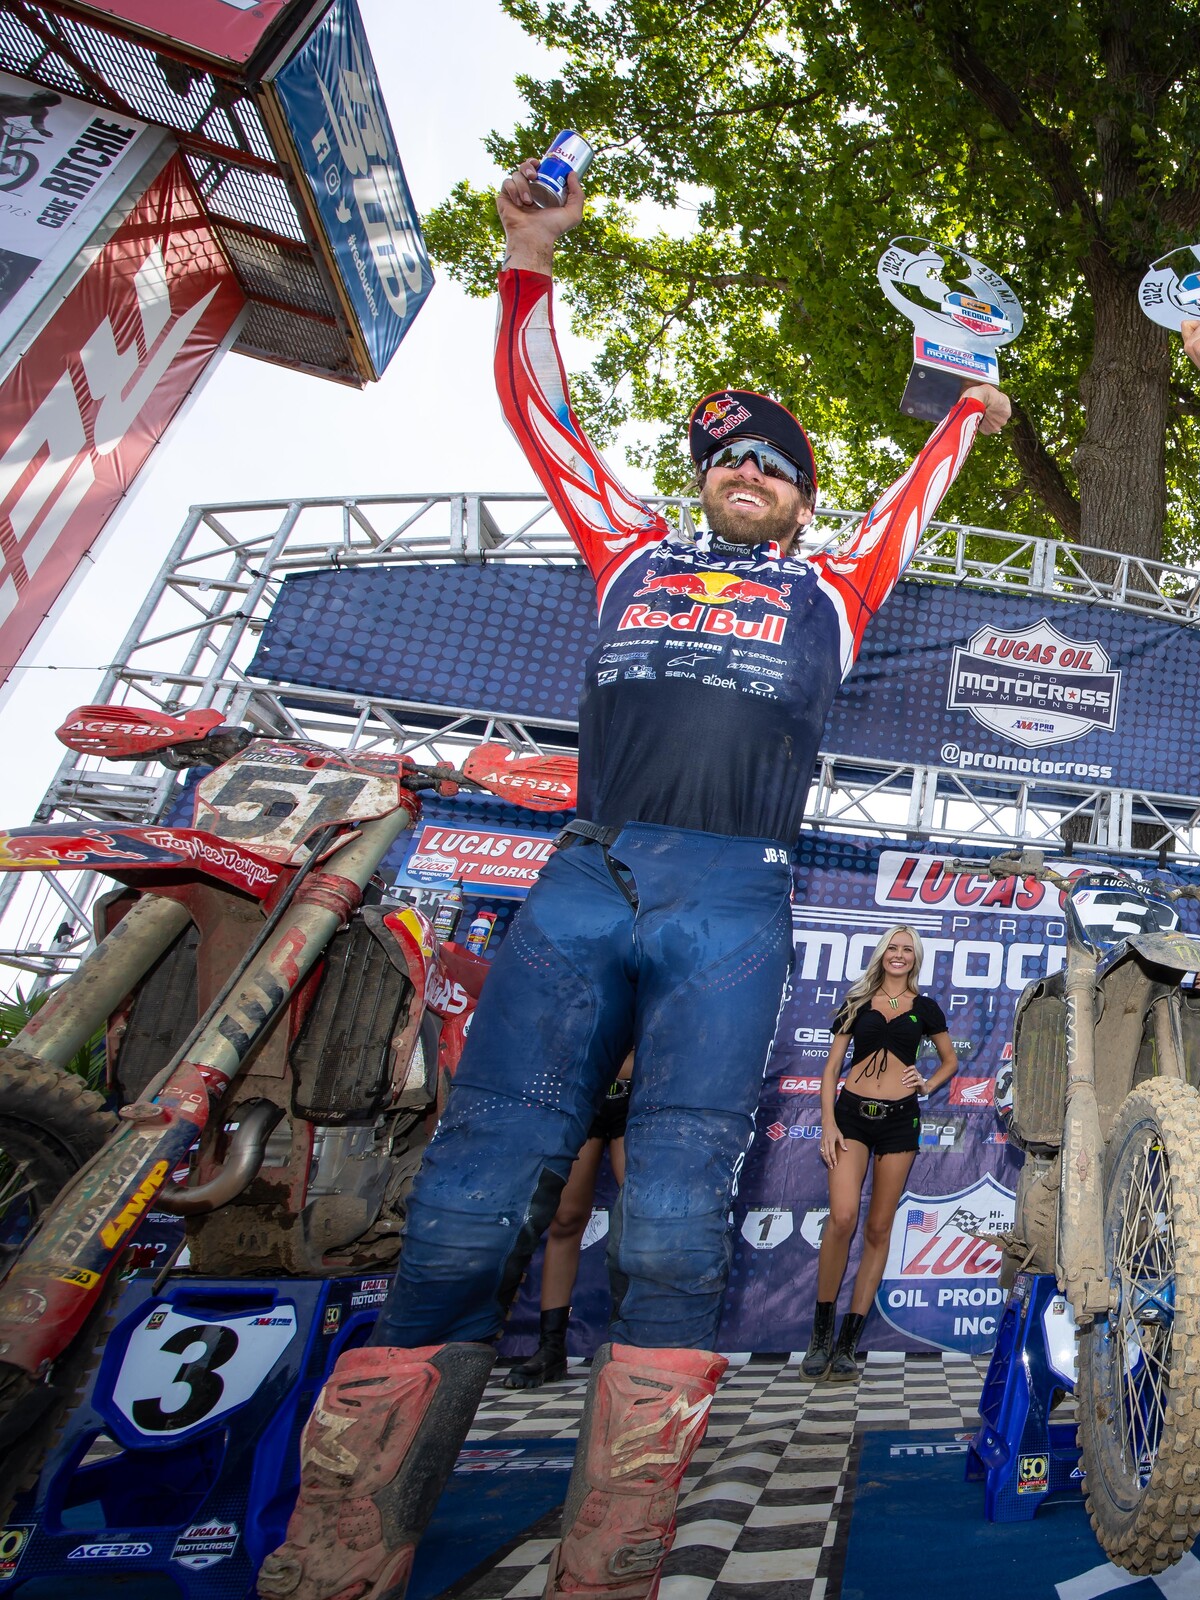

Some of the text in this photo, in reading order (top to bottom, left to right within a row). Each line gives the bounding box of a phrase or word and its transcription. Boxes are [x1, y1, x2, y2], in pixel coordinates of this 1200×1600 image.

[36, 117, 137, 229] GENE RITCHIE
[882, 252, 906, 276] 2022
[347, 234, 380, 319] #redbudmx
[997, 289, 1017, 305] MX
[1143, 282, 1163, 306] 2022
[961, 309, 993, 323] REDBUD
[926, 349, 987, 371] MOTOCROSS
[709, 405, 752, 440] Red Bull
[0, 240, 222, 625] RE
[712, 542, 736, 552] FACTORY
[617, 603, 788, 646] Red Bull
[610, 640, 659, 648] DUNLOP
[665, 639, 723, 652] METHOD
[747, 651, 788, 666] seaspan
[983, 636, 1094, 671] LUCAS OIL
[664, 671, 697, 679] SENA
[741, 663, 761, 671] PRO
[761, 668, 784, 679] TORK
[1018, 672, 1057, 684] PRO
[741, 687, 779, 700] OAKLEY
[958, 671, 1111, 707] MOTOCROSS
[957, 687, 1109, 714] CHAMPIONSHIP
[65, 721, 175, 737] ACERBIS
[1011, 719, 1055, 731] AMA PRO
[241, 753, 301, 765] LUCAS OIL
[940, 743, 1112, 779] @promotocross
[481, 771, 572, 794] ACERBIS
[203, 765, 369, 845] 51
[425, 832, 554, 862] LUCAS OIL
[145, 831, 198, 860] Troy
[221, 848, 278, 886] Designs
[413, 860, 452, 871] LUCAS
[458, 862, 541, 880] IT WORKS
[886, 857, 1046, 911] LUCAS
[952, 916, 1065, 938] PRO
[793, 929, 1066, 991] MOTOC
[304, 1109, 346, 1120] Twin Air
[788, 1125, 822, 1140] SUZ
[989, 1210, 1004, 1219] HI-
[758, 1214, 774, 1241] 1
[888, 1289, 929, 1308] OIL
[1054, 1302, 1064, 1311] 50
[152, 1313, 165, 1323] 50
[248, 1318, 275, 1326] AMA
[327, 1308, 339, 1322] 50
[954, 1316, 998, 1336] INC.
[132, 1324, 239, 1431] 3
[1021, 1458, 1046, 1479] 50
[187, 1526, 232, 1538] LUCAS OIL
[68, 1544, 152, 1558] ACERBIS
[176, 1541, 234, 1552] MOTOCROSS
